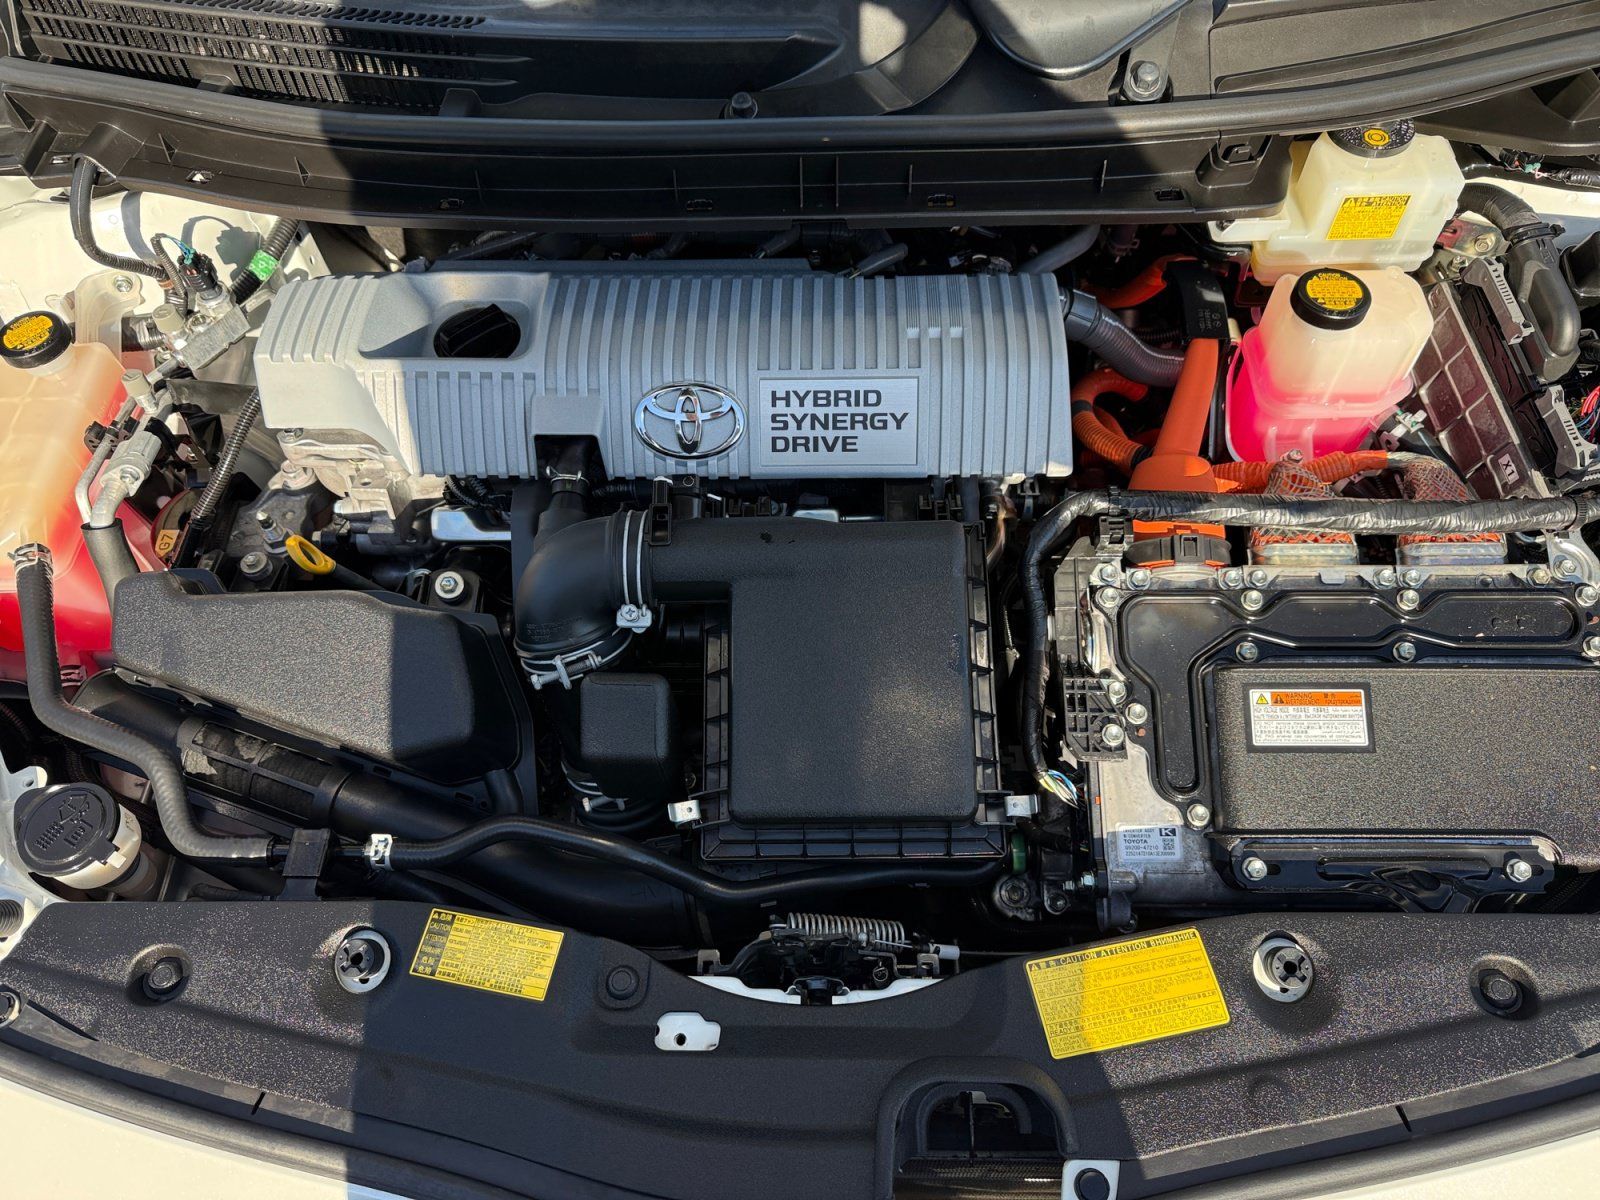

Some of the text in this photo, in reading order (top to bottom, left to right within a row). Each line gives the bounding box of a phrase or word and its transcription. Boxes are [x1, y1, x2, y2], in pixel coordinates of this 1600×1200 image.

[771, 389, 882, 408] HYBRID
[770, 412, 910, 431] SYNERGY
[771, 435, 859, 453] DRIVE
[1502, 460, 1515, 477] X1
[158, 533, 174, 551] G7
[430, 921, 451, 932] CAUTION
[1059, 951, 1098, 965] CAUTION
[1100, 941, 1148, 958] ATTENTION
[1150, 931, 1196, 947] ВНИМАНИЕ
